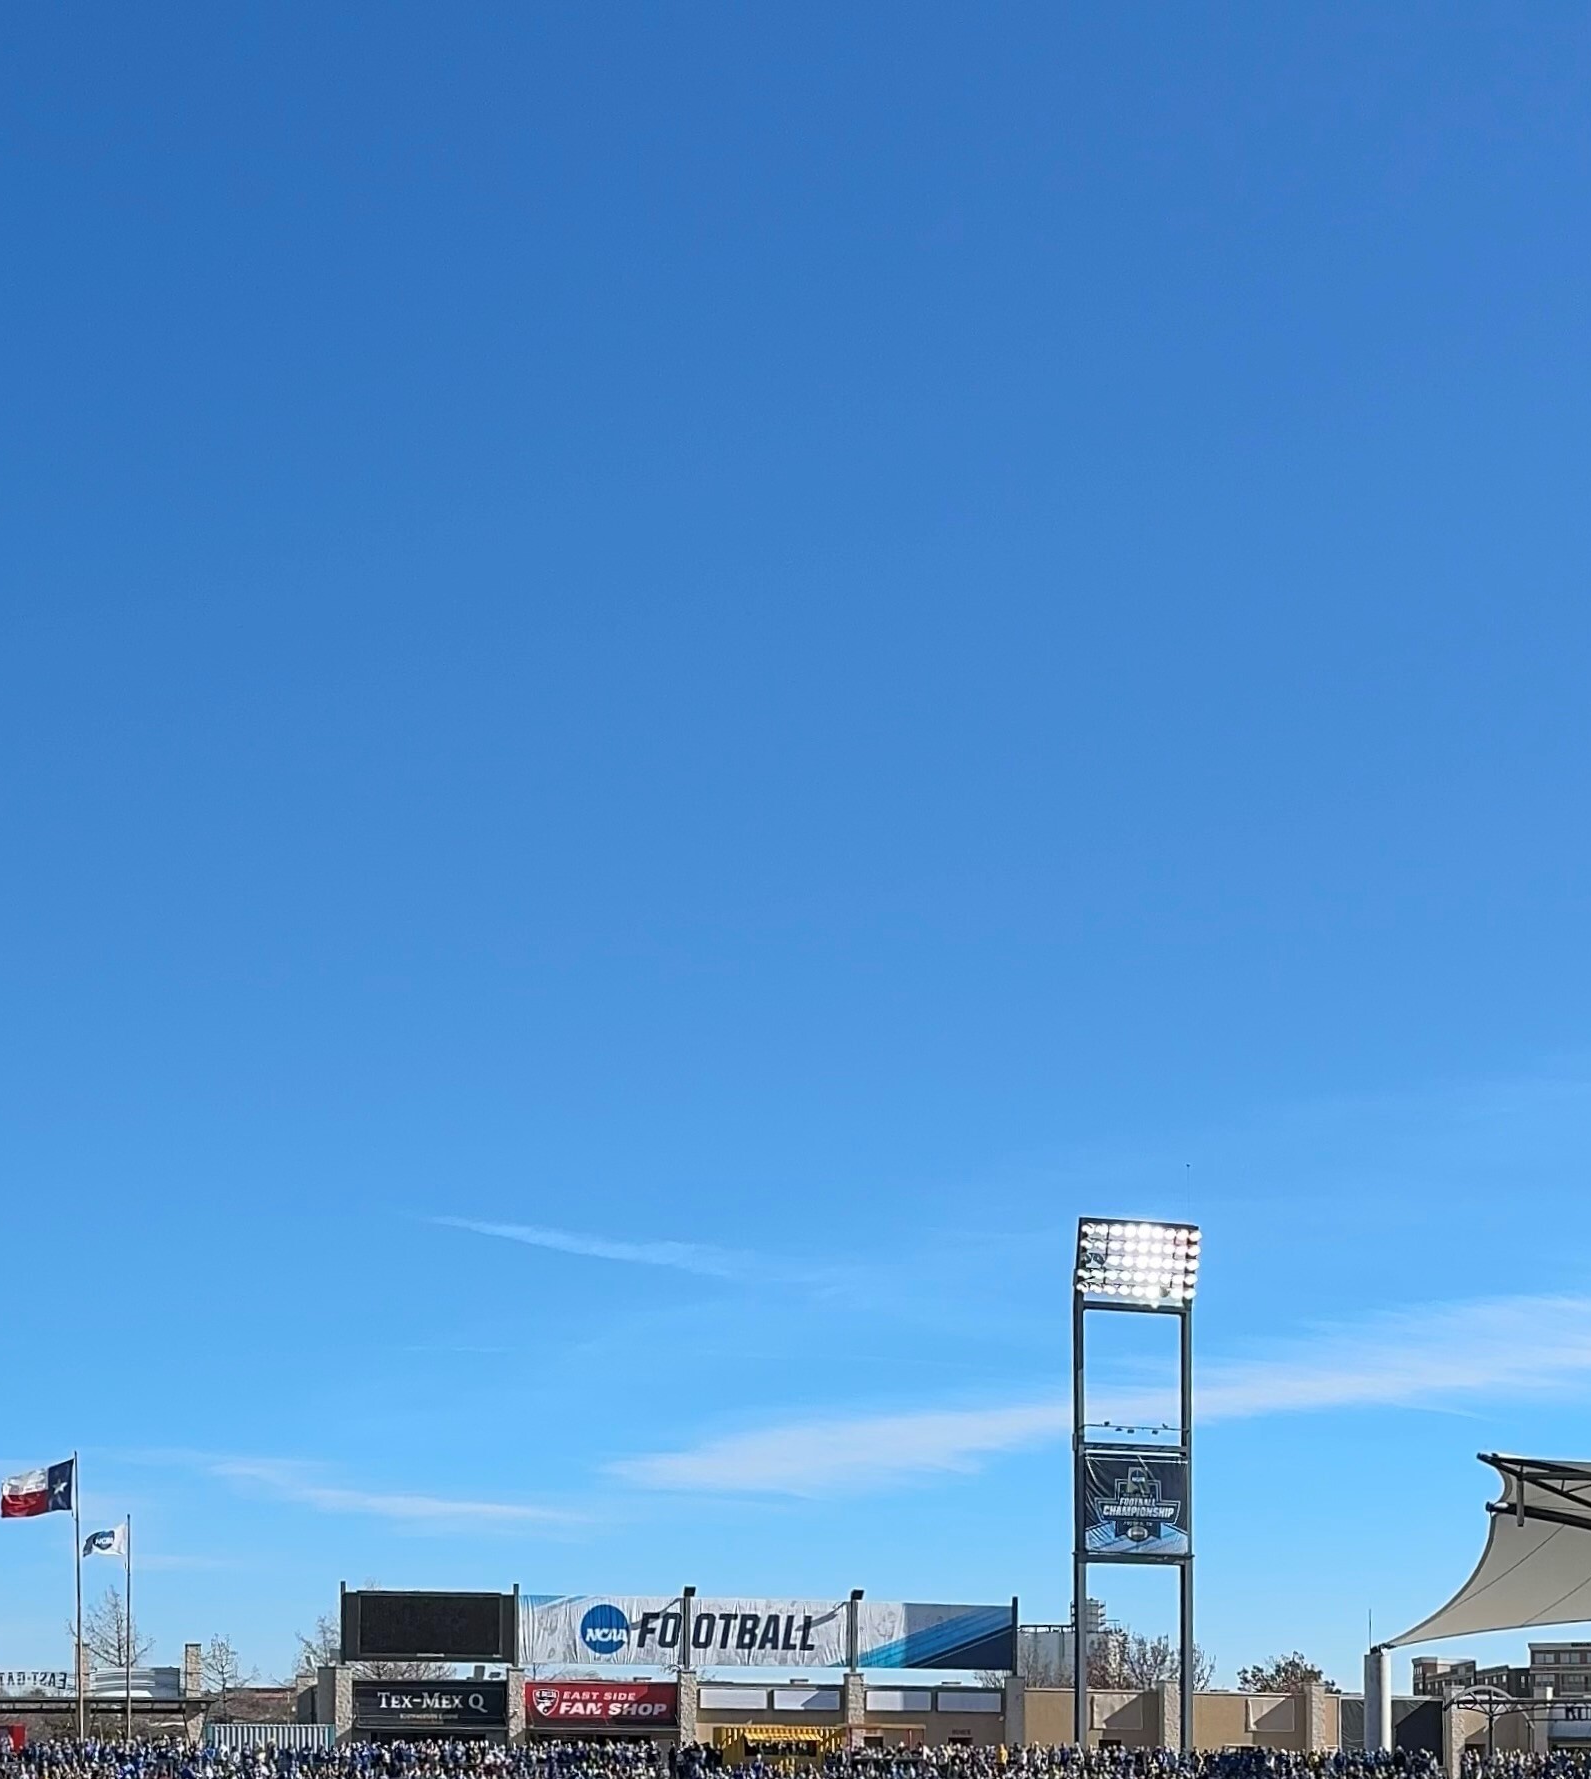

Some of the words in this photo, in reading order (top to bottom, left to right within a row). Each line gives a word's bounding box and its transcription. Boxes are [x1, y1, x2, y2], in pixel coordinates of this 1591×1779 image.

[1119, 1497, 1156, 1507] FOOTBALL
[1103, 1505, 1174, 1518] CHAMPIONSHIP
[586, 1628, 628, 1642] NCAA
[637, 1612, 815, 1651] FOOTBALL
[563, 1691, 604, 1701] EAST
[609, 1692, 636, 1701] SIDE
[469, 1693, 488, 1713] Q
[558, 1702, 602, 1715] FAN
[608, 1704, 667, 1716] SHOP
